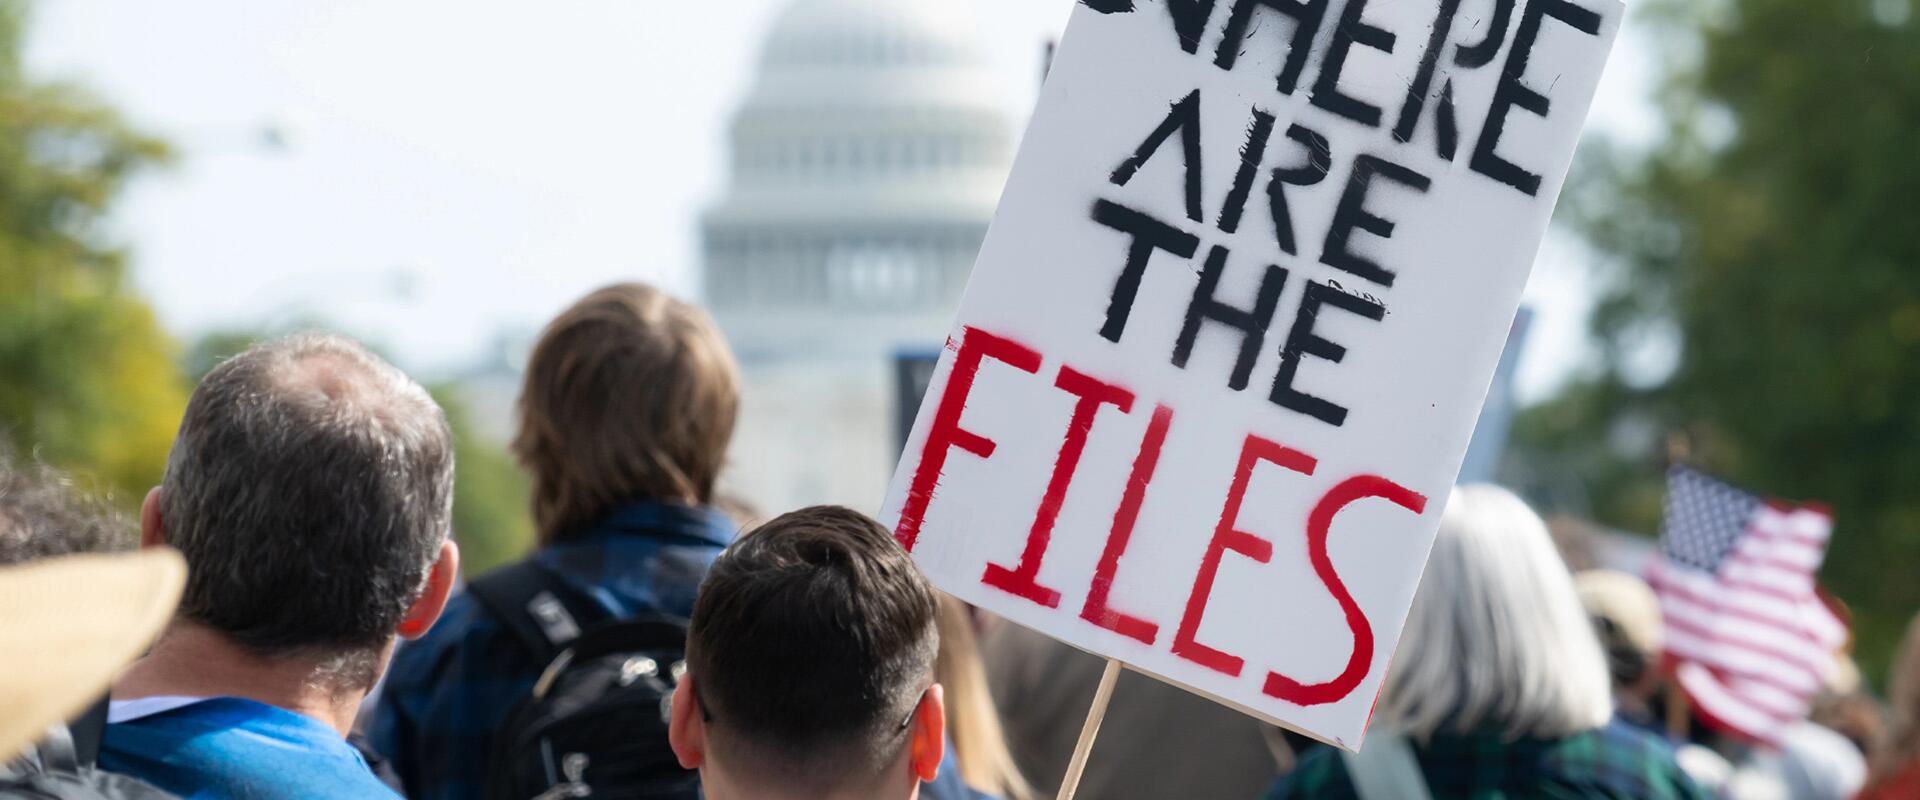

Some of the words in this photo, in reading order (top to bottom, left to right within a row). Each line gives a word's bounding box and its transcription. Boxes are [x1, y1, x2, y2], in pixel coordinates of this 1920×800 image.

[1077, 0, 1602, 197] HERE
[1110, 89, 1430, 287] ARE
[1092, 198, 1387, 426] THE
[896, 326, 1427, 706] FILES
